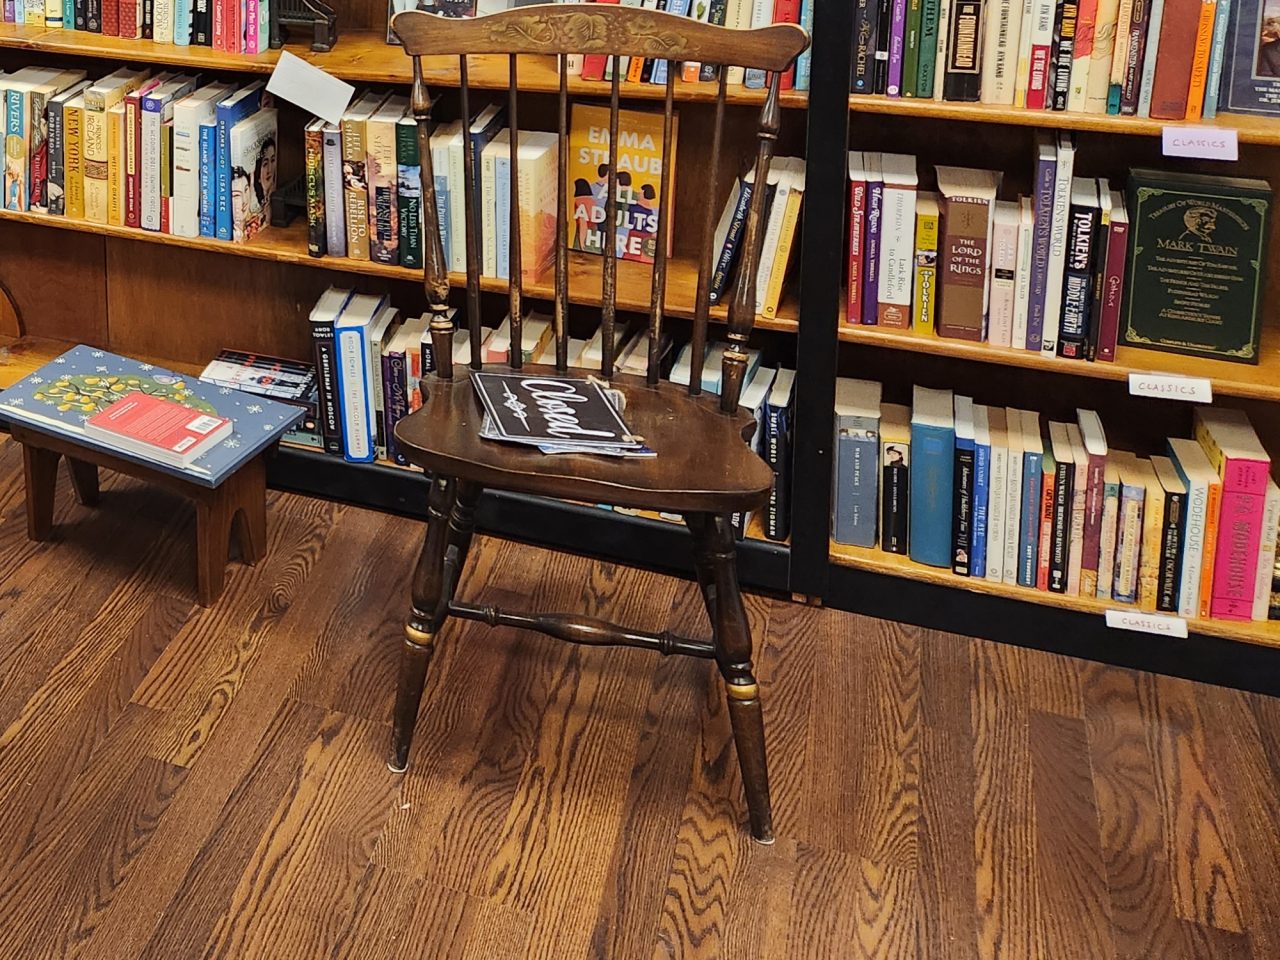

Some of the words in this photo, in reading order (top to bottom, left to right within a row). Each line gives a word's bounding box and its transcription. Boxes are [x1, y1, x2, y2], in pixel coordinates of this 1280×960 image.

[955, 15, 976, 67] FOUNTAINHEAD
[10, 91, 20, 133] RIVERS
[67, 109, 78, 137] NEW
[352, 133, 360, 152] JEFF
[589, 127, 656, 151] EMMA
[1172, 138, 1226, 149] CLASSICS
[69, 138, 80, 173] YORK
[357, 200, 365, 220] RISE
[951, 197, 989, 205] TOLKIEN
[349, 192, 358, 243] REBELLION
[586, 230, 641, 254] HRE
[952, 246, 982, 256] LORD
[1073, 213, 1093, 270] TOLKIEN'S
[1157, 238, 1194, 252] MARK
[1198, 242, 1239, 257] TWAIN
[950, 264, 982, 275] RINGS
[322, 352, 332, 396] GENTLEMAN
[327, 403, 335, 430] MOSCOW
[1138, 382, 1196, 395] CLASSICS
[520, 378, 616, 439] Closed
[1188, 487, 1205, 553] WODEHOUSE
[1122, 617, 1171, 631] CLASSICS
